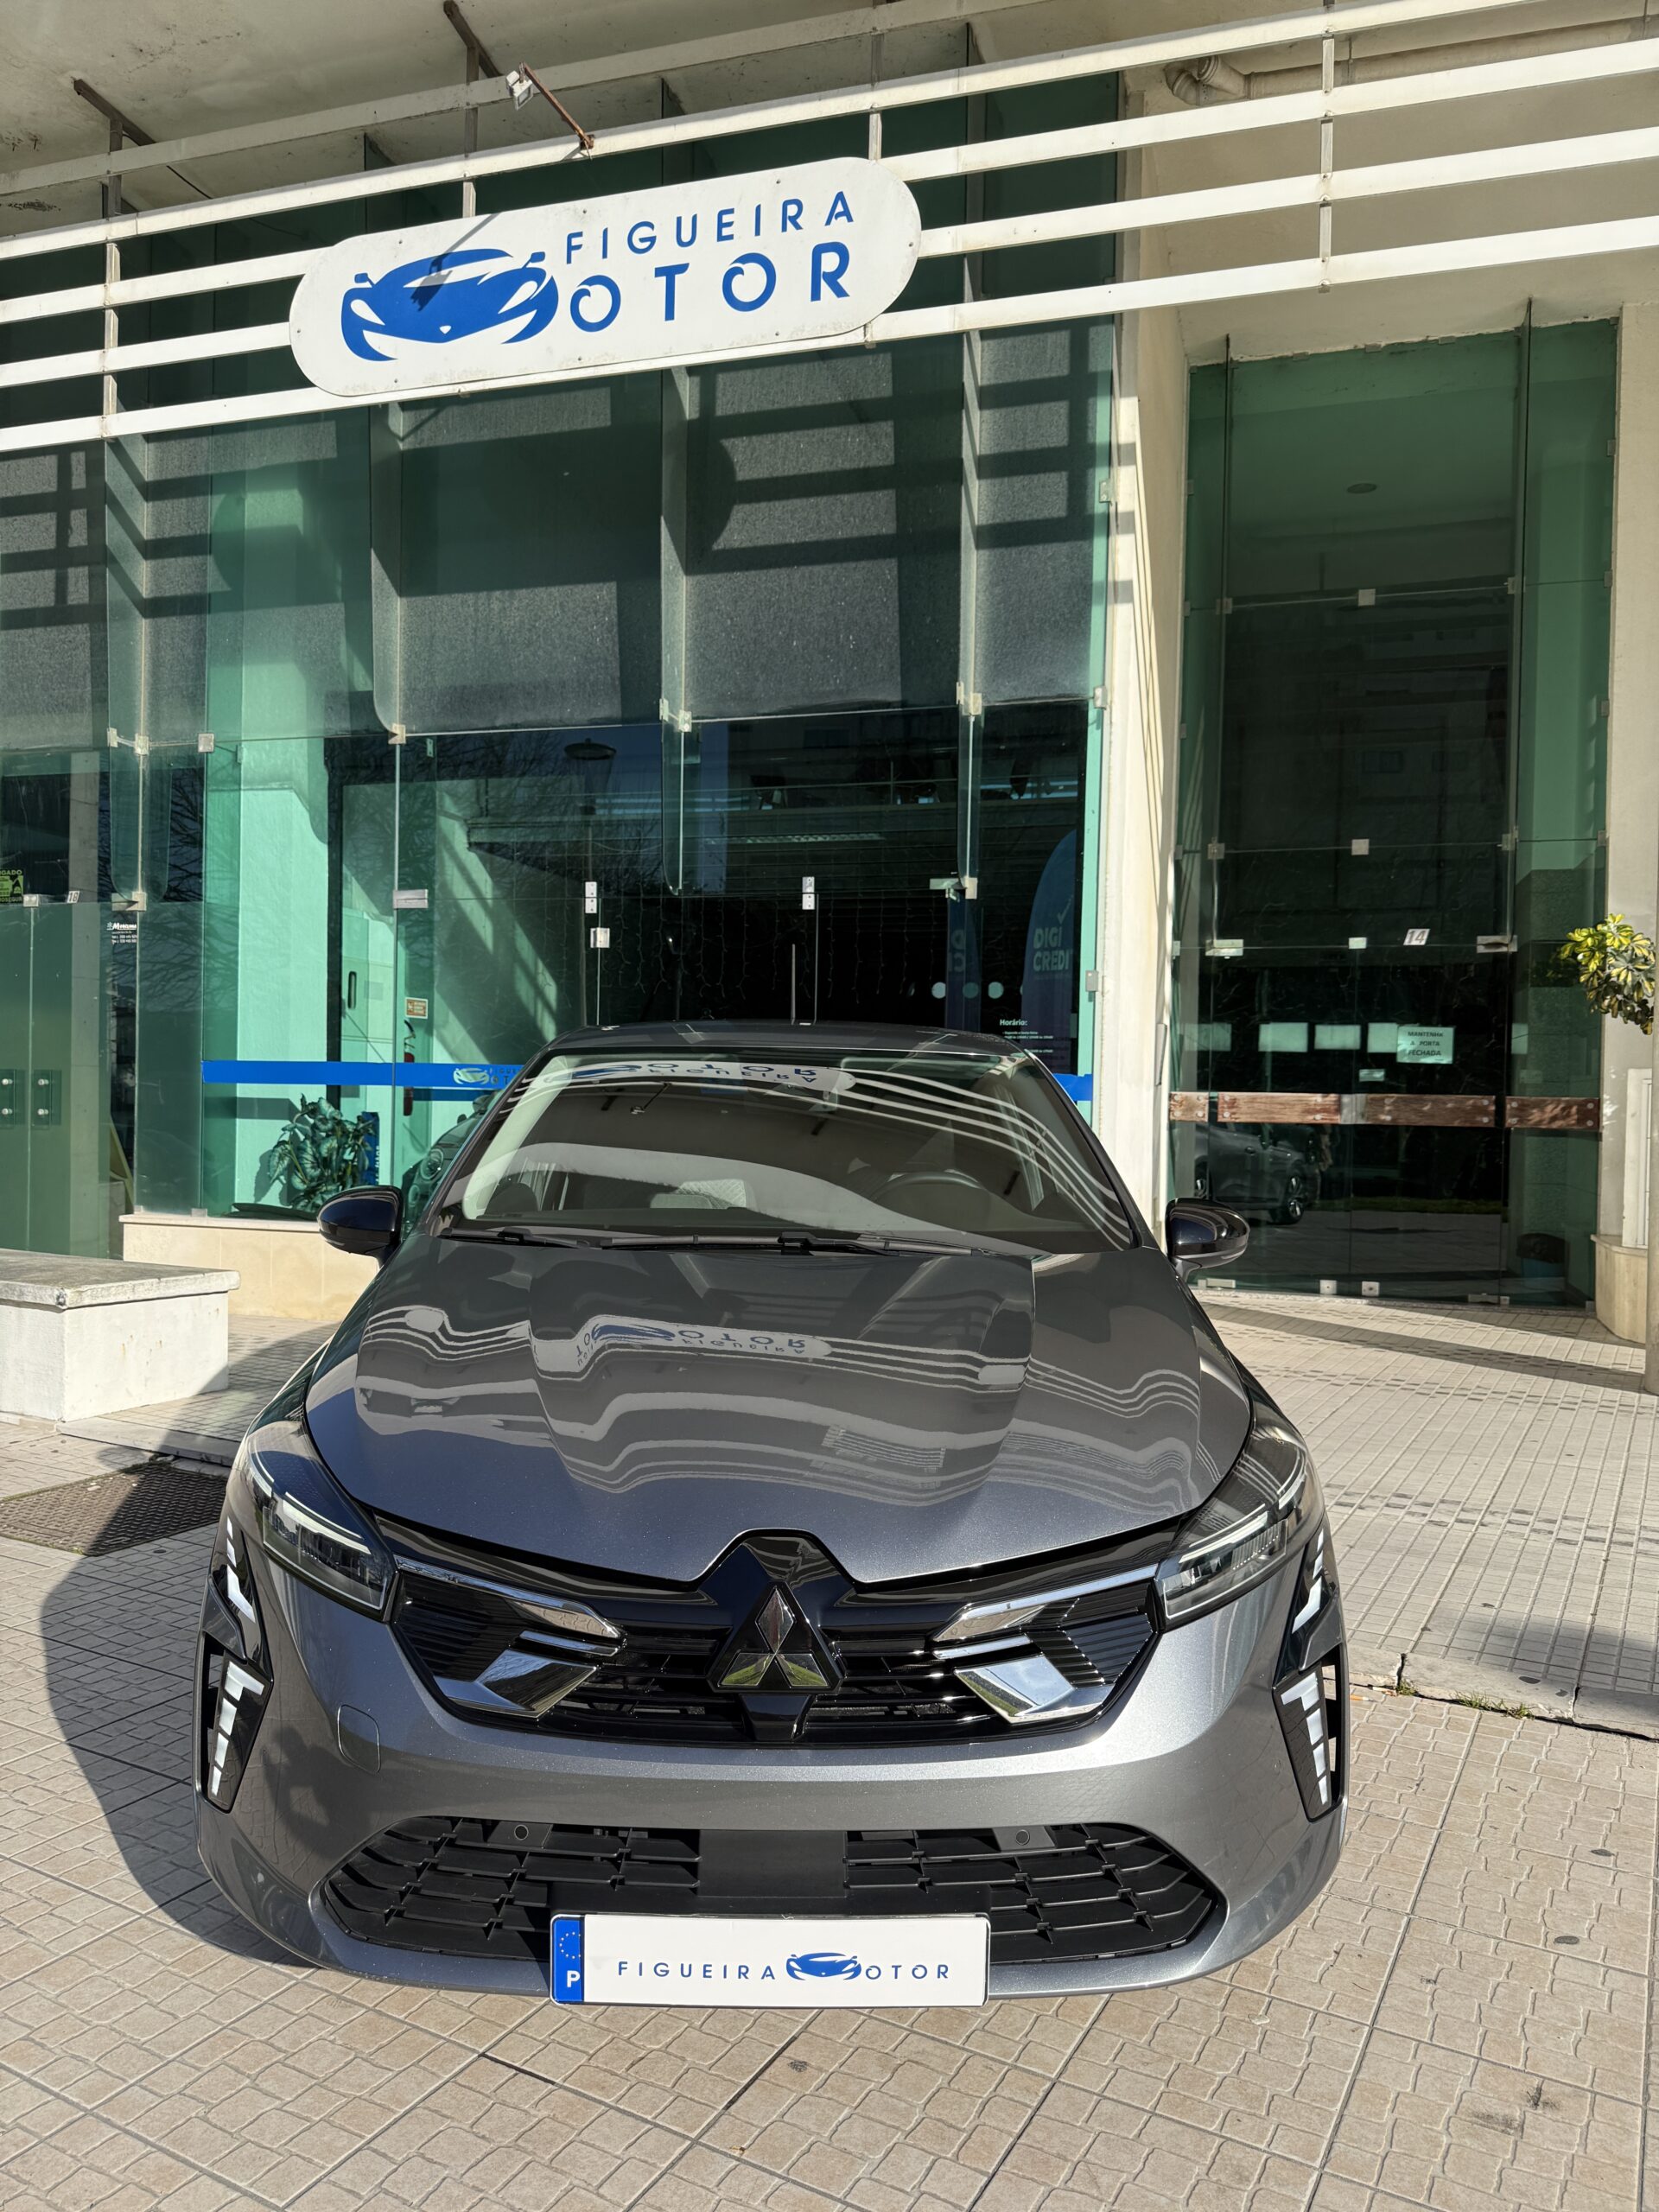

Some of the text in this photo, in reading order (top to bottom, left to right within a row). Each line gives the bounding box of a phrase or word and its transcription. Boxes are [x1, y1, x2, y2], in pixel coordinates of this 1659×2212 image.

[566, 191, 854, 264] FIGUEIRA
[569, 241, 850, 333] OTOR
[1033, 926, 1062, 949] DIGI
[1408, 931, 1426, 944] 14
[567, 1970, 580, 1987] P
[618, 1961, 950, 1980] FIGUEIRA OTOR
